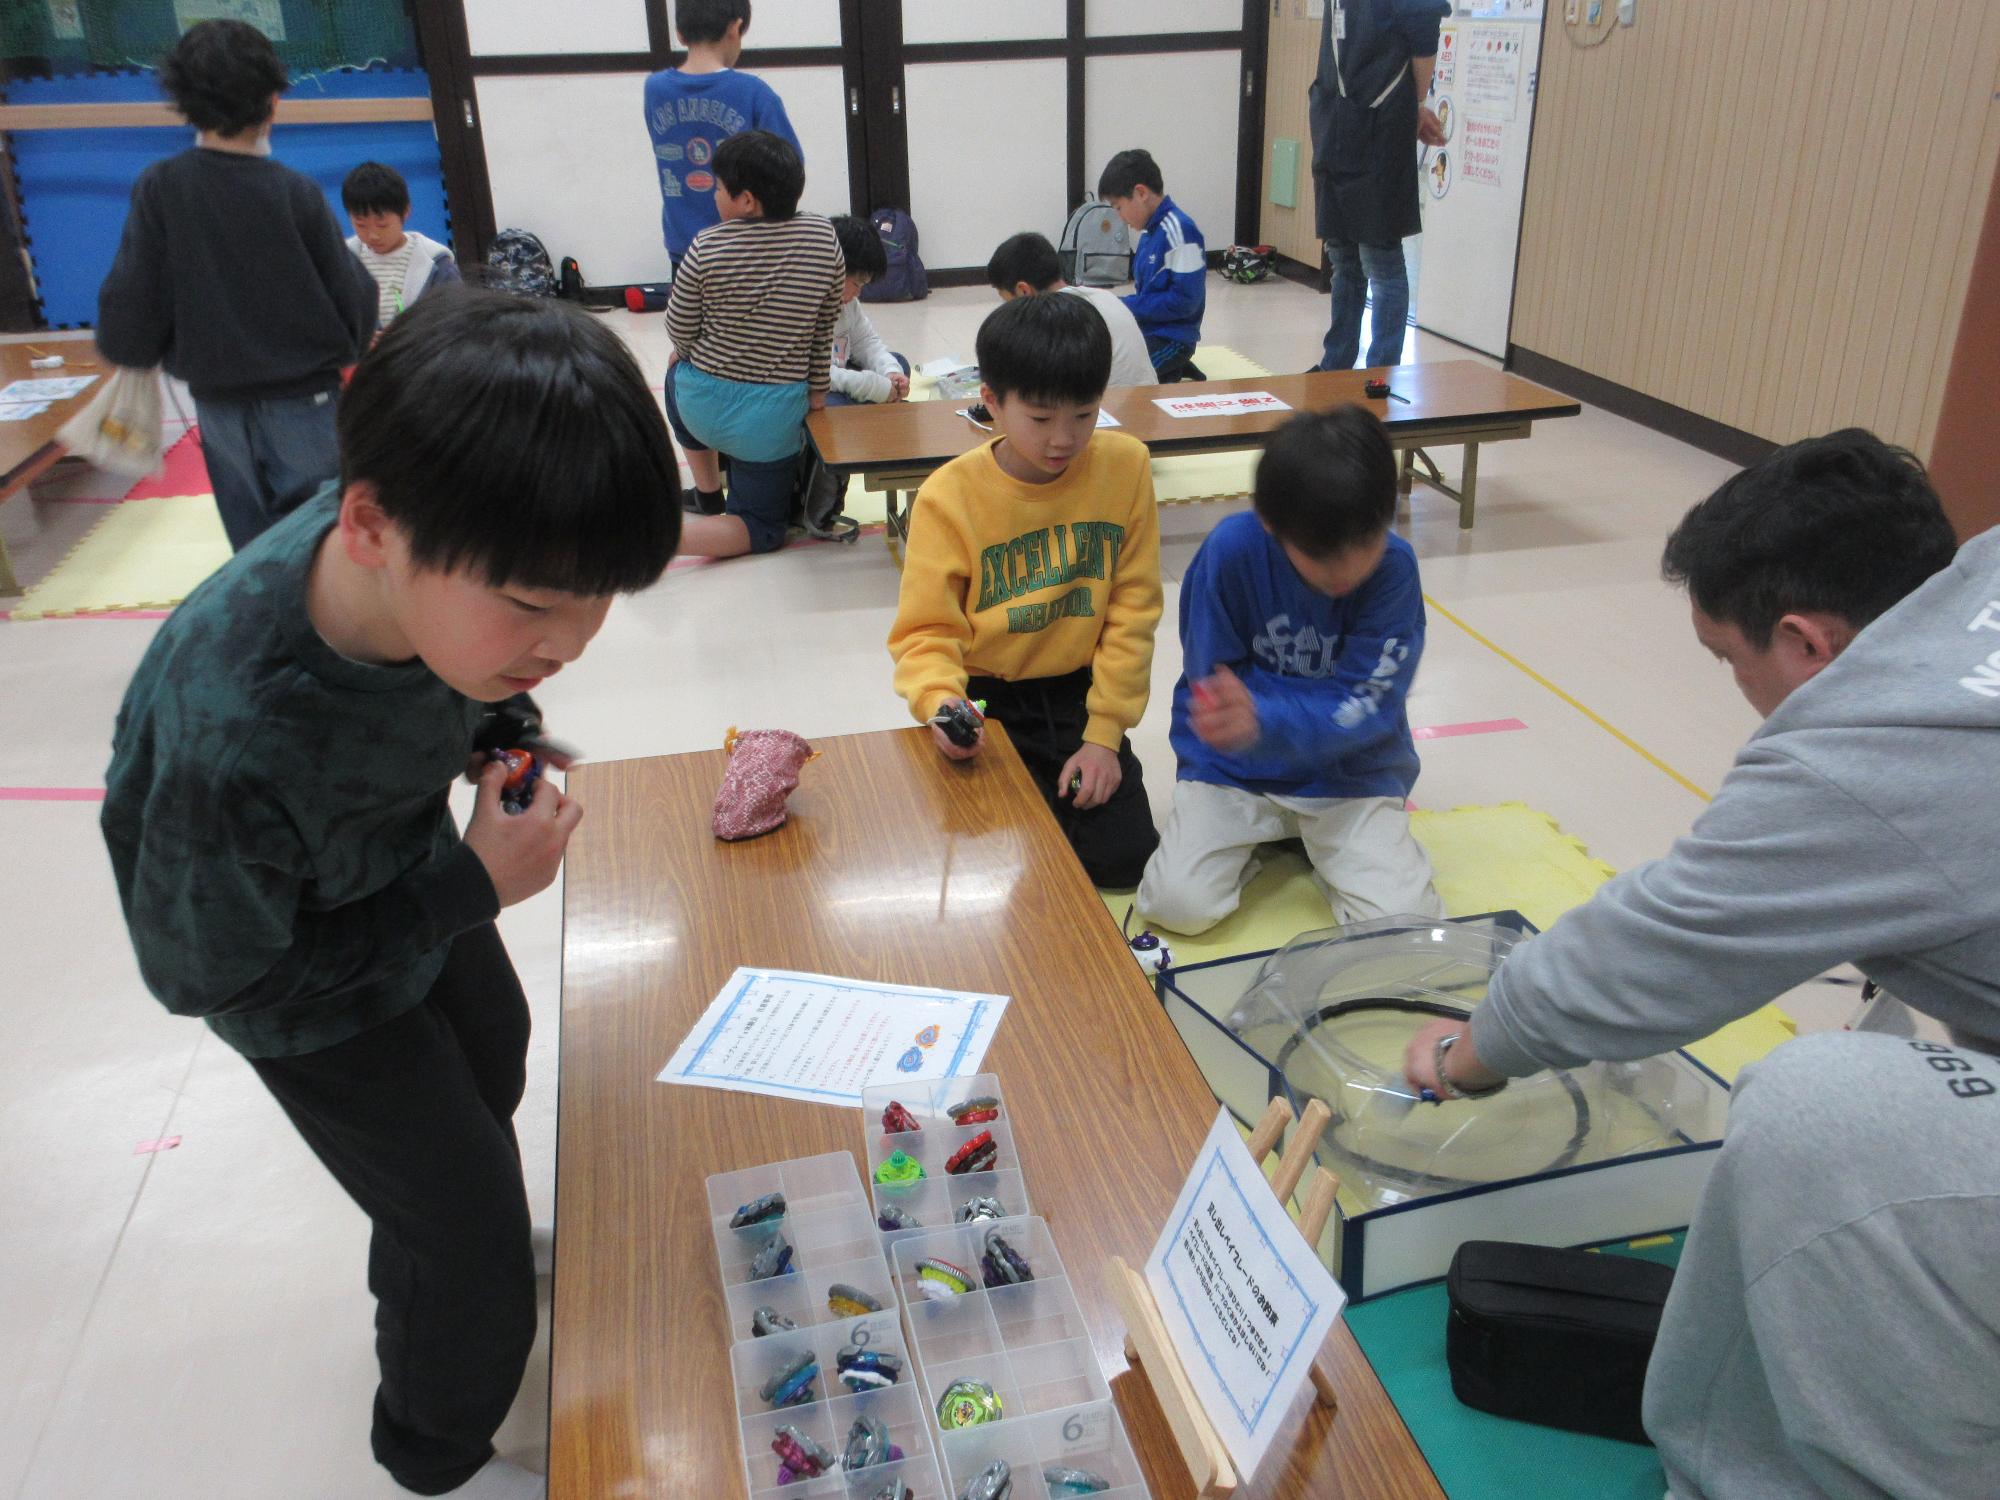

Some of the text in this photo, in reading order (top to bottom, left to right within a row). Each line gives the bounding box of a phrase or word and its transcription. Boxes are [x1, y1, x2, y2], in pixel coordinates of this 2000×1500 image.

[652, 98, 746, 136] LOS ANGELES
[975, 522, 1125, 613] EXCELLENT
[850, 1320, 870, 1346] 6
[1062, 1412, 1083, 1442] 6
